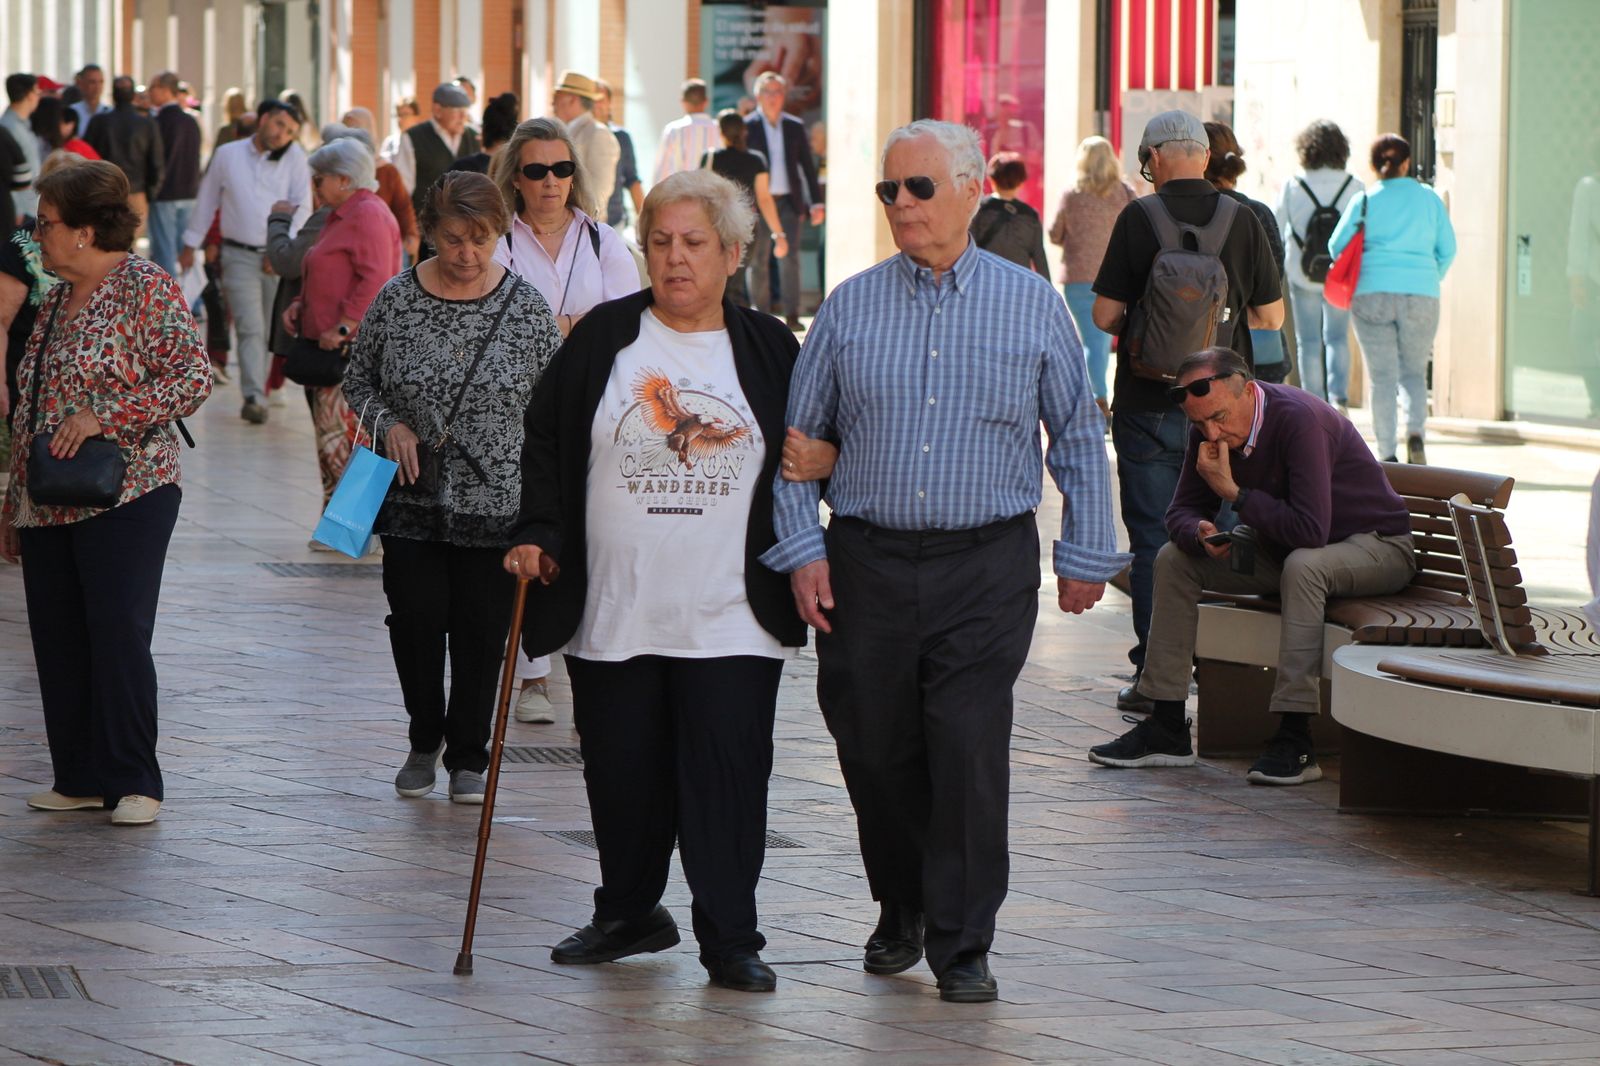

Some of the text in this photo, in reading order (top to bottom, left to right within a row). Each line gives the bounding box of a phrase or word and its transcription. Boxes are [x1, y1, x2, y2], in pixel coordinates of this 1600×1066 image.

[620, 451, 745, 480] CANYON
[627, 480, 730, 496] WANDERER
[679, 497, 718, 507] CHILD
